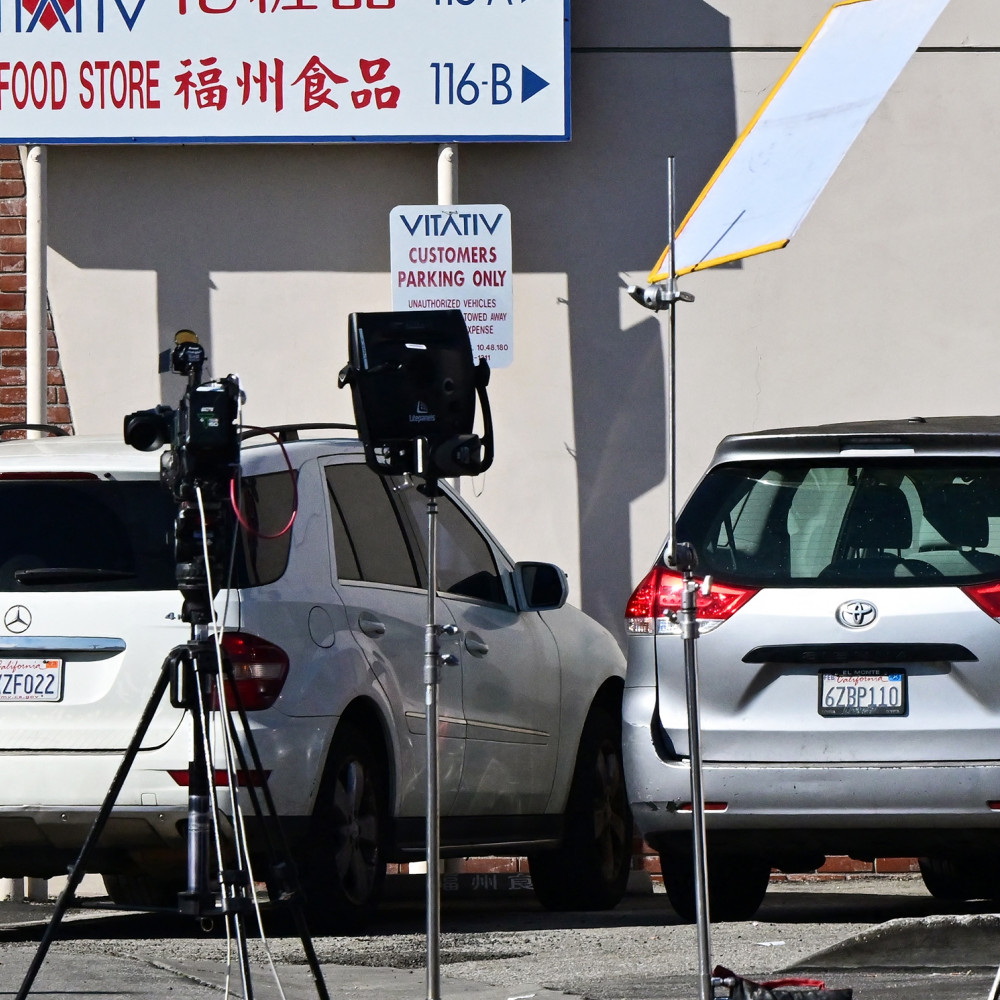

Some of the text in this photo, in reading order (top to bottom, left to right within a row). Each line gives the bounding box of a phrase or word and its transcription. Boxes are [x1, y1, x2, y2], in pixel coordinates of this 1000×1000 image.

[0, 60, 161, 111] FOOD STORE
[174, 55, 512, 113] 福州食品 116-B
[399, 213, 504, 237] VITATIV
[408, 246, 498, 264] CUSTOMERS
[398, 270, 507, 288] PARKING ONLY
[408, 298, 497, 309] UNAUTHORIZED VEHICLES
[464, 312, 507, 322] TOWED AWAY
[467, 325, 494, 335] XPENSE
[0, 673, 55, 695] ZF022
[825, 686, 898, 708] 6ZBP110
